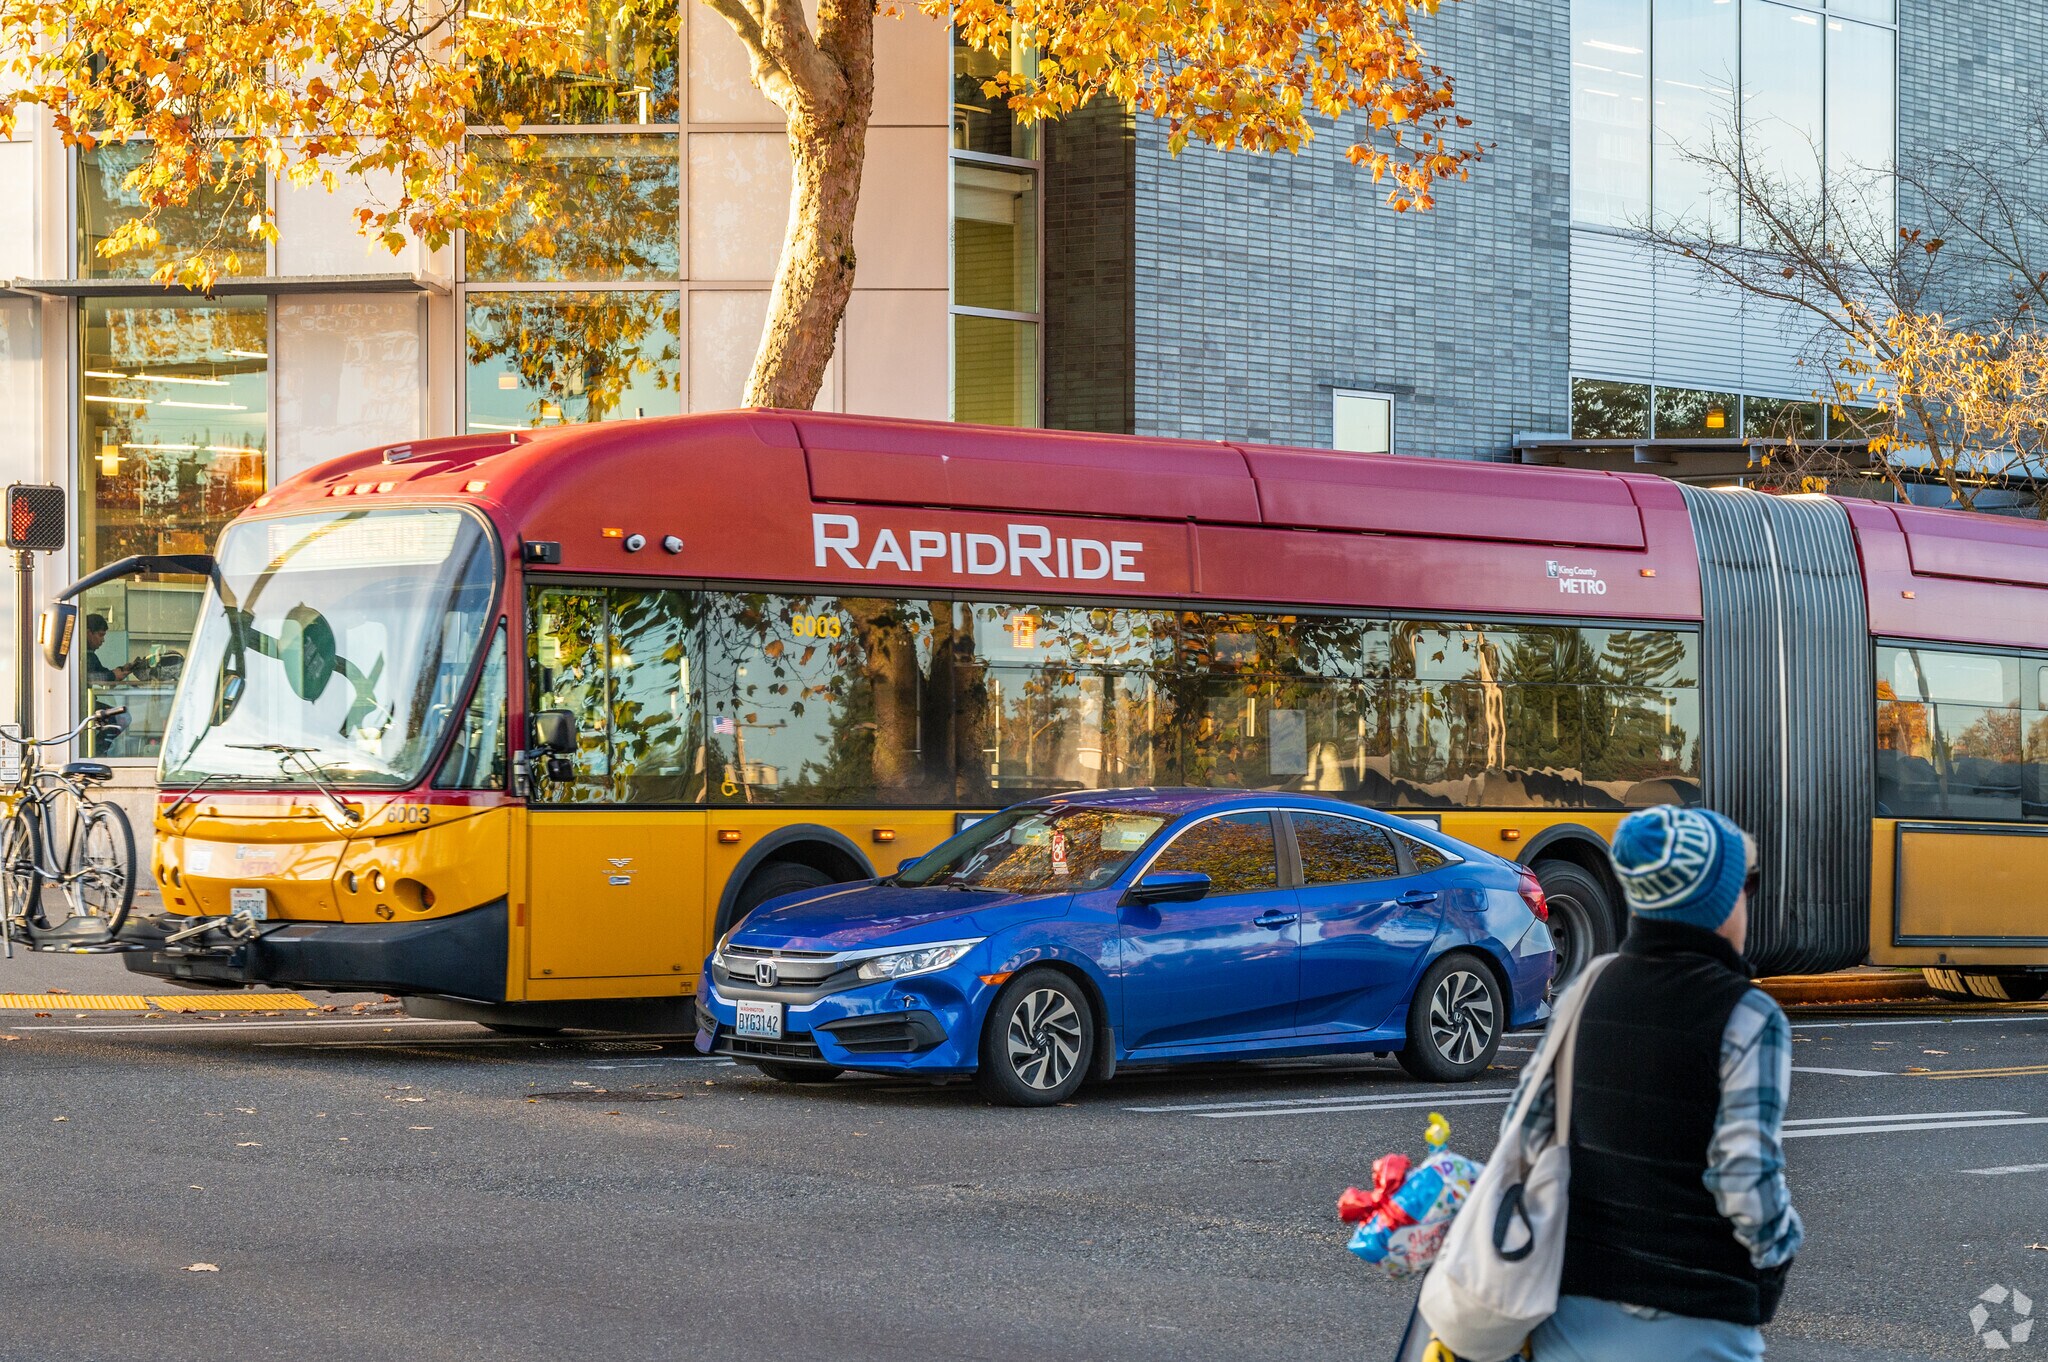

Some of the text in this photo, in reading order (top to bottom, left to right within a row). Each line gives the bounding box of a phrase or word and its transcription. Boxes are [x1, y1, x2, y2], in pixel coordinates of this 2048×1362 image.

[1559, 566, 1597, 577] King County
[1560, 578, 1607, 595] METRO
[792, 615, 841, 638] 6003
[387, 806, 430, 824] 6003
[739, 1013, 778, 1032] BYG3142
